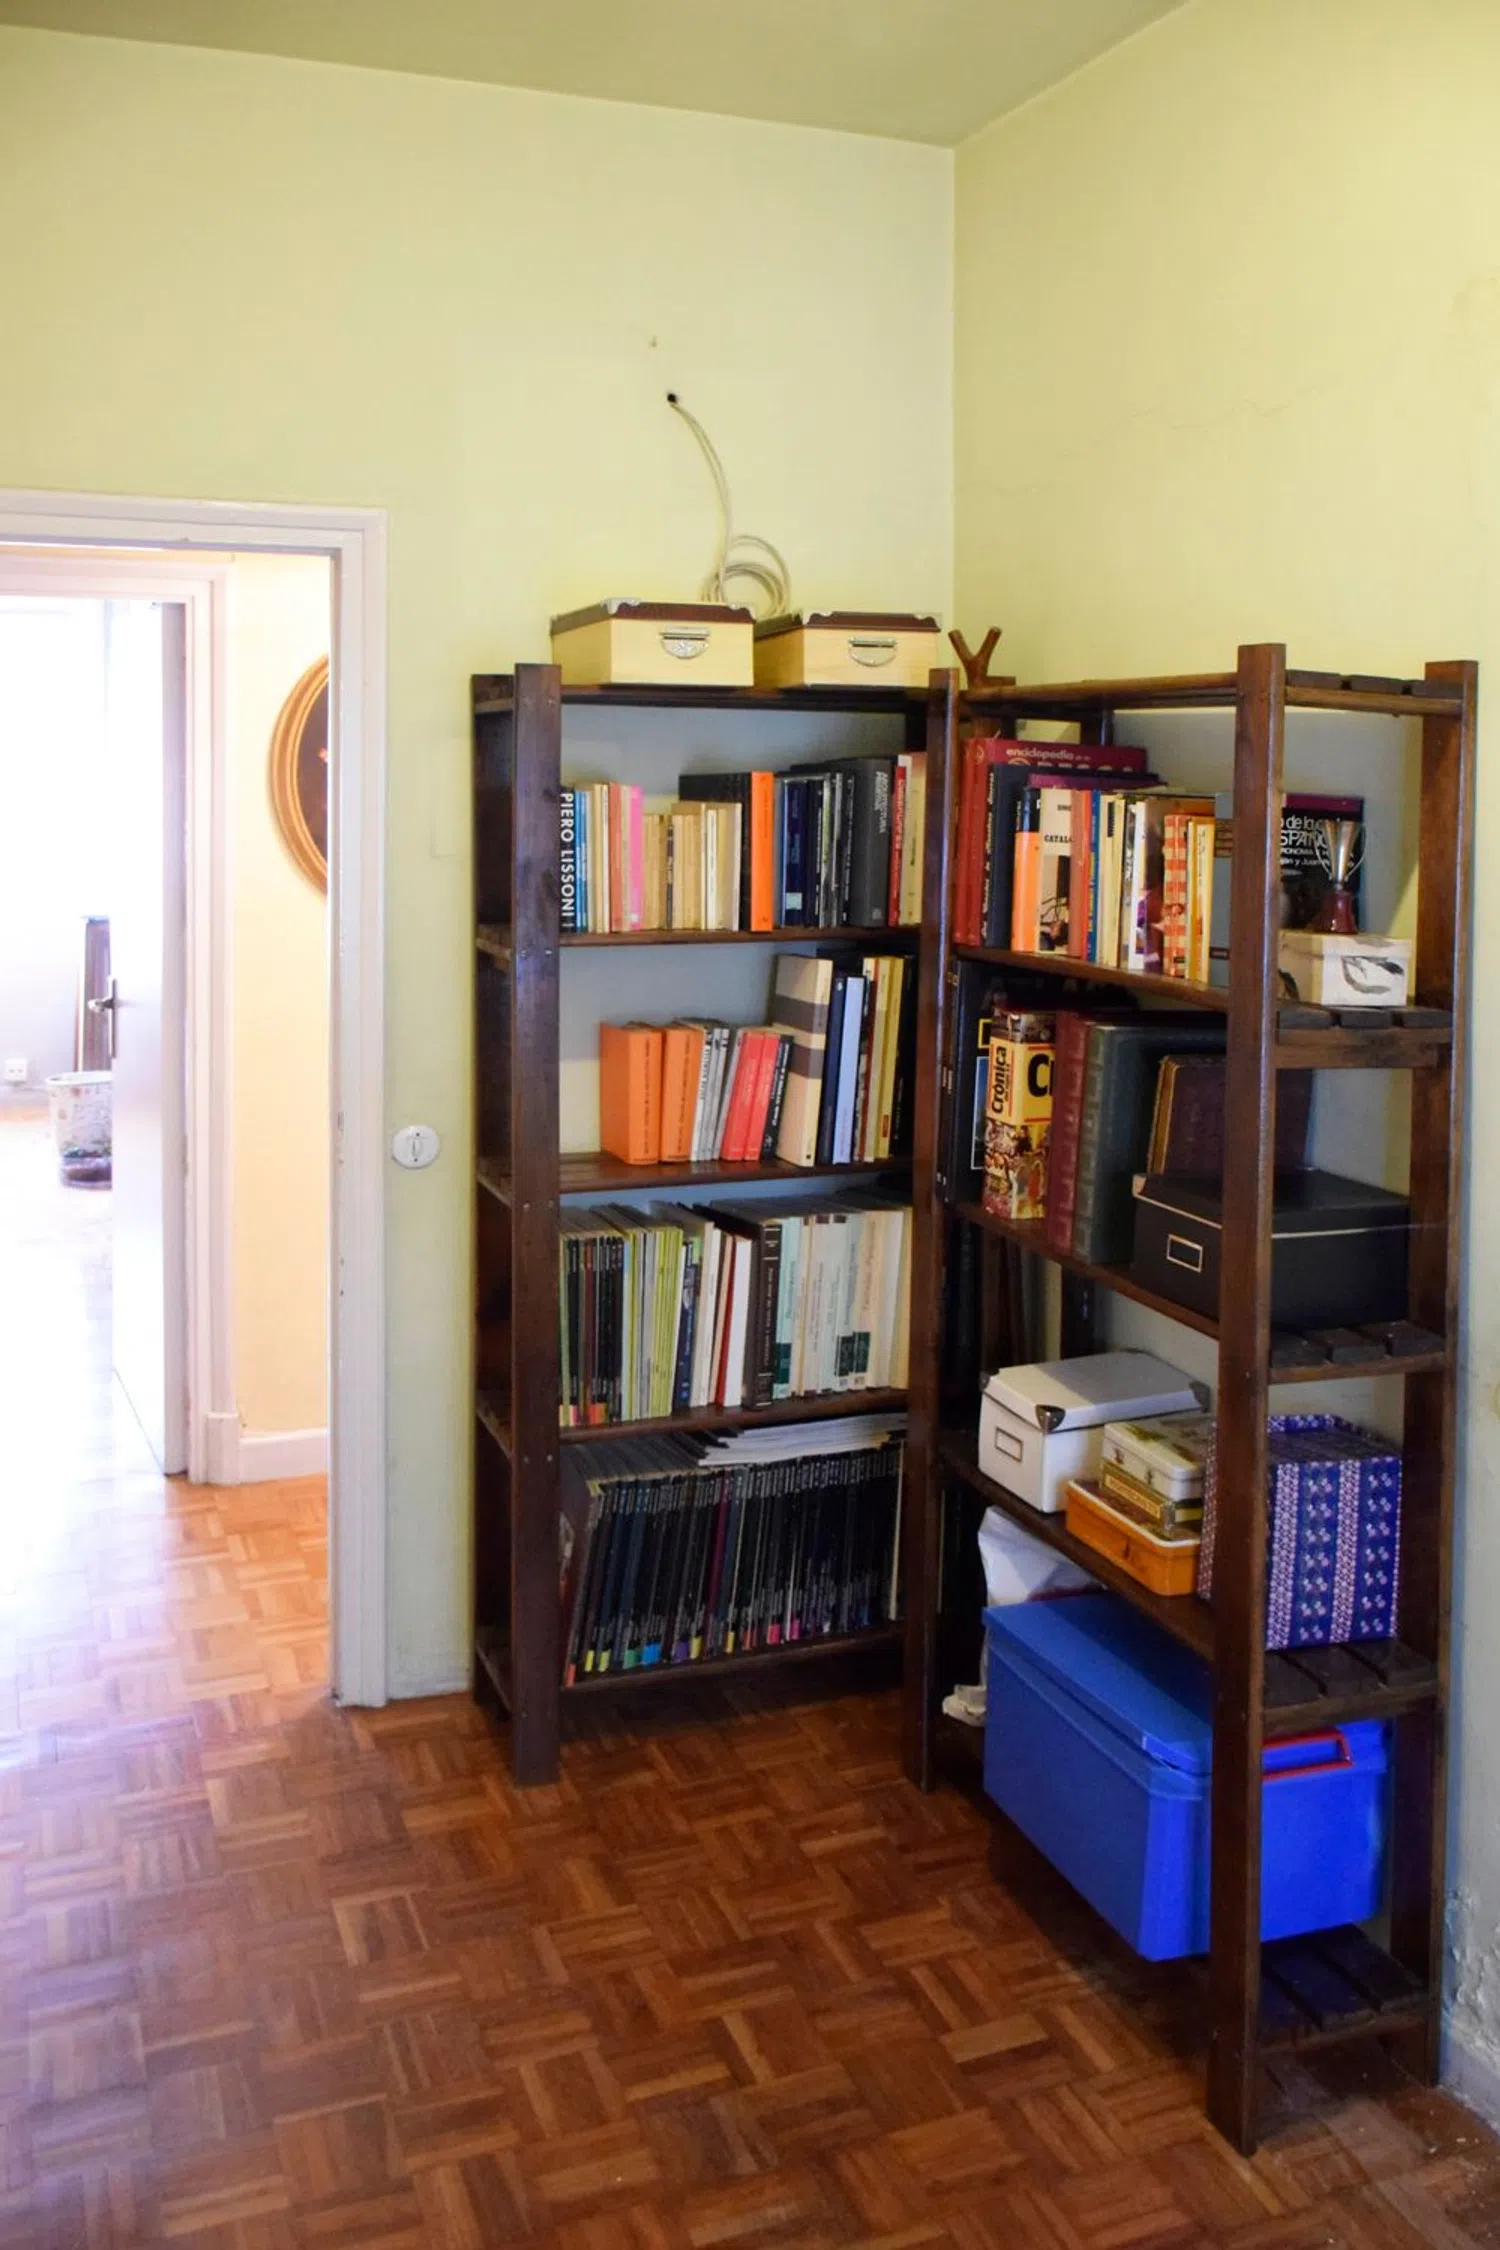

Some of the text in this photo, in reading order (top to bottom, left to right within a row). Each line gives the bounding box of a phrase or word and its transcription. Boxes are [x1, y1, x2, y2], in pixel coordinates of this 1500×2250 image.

[1005, 748, 1074, 761] enciclopedia
[560, 792, 574, 843] PIERO
[1286, 814, 1303, 830] de
[561, 850, 574, 917] LISSONI
[991, 1045, 1007, 1114] Crónica
